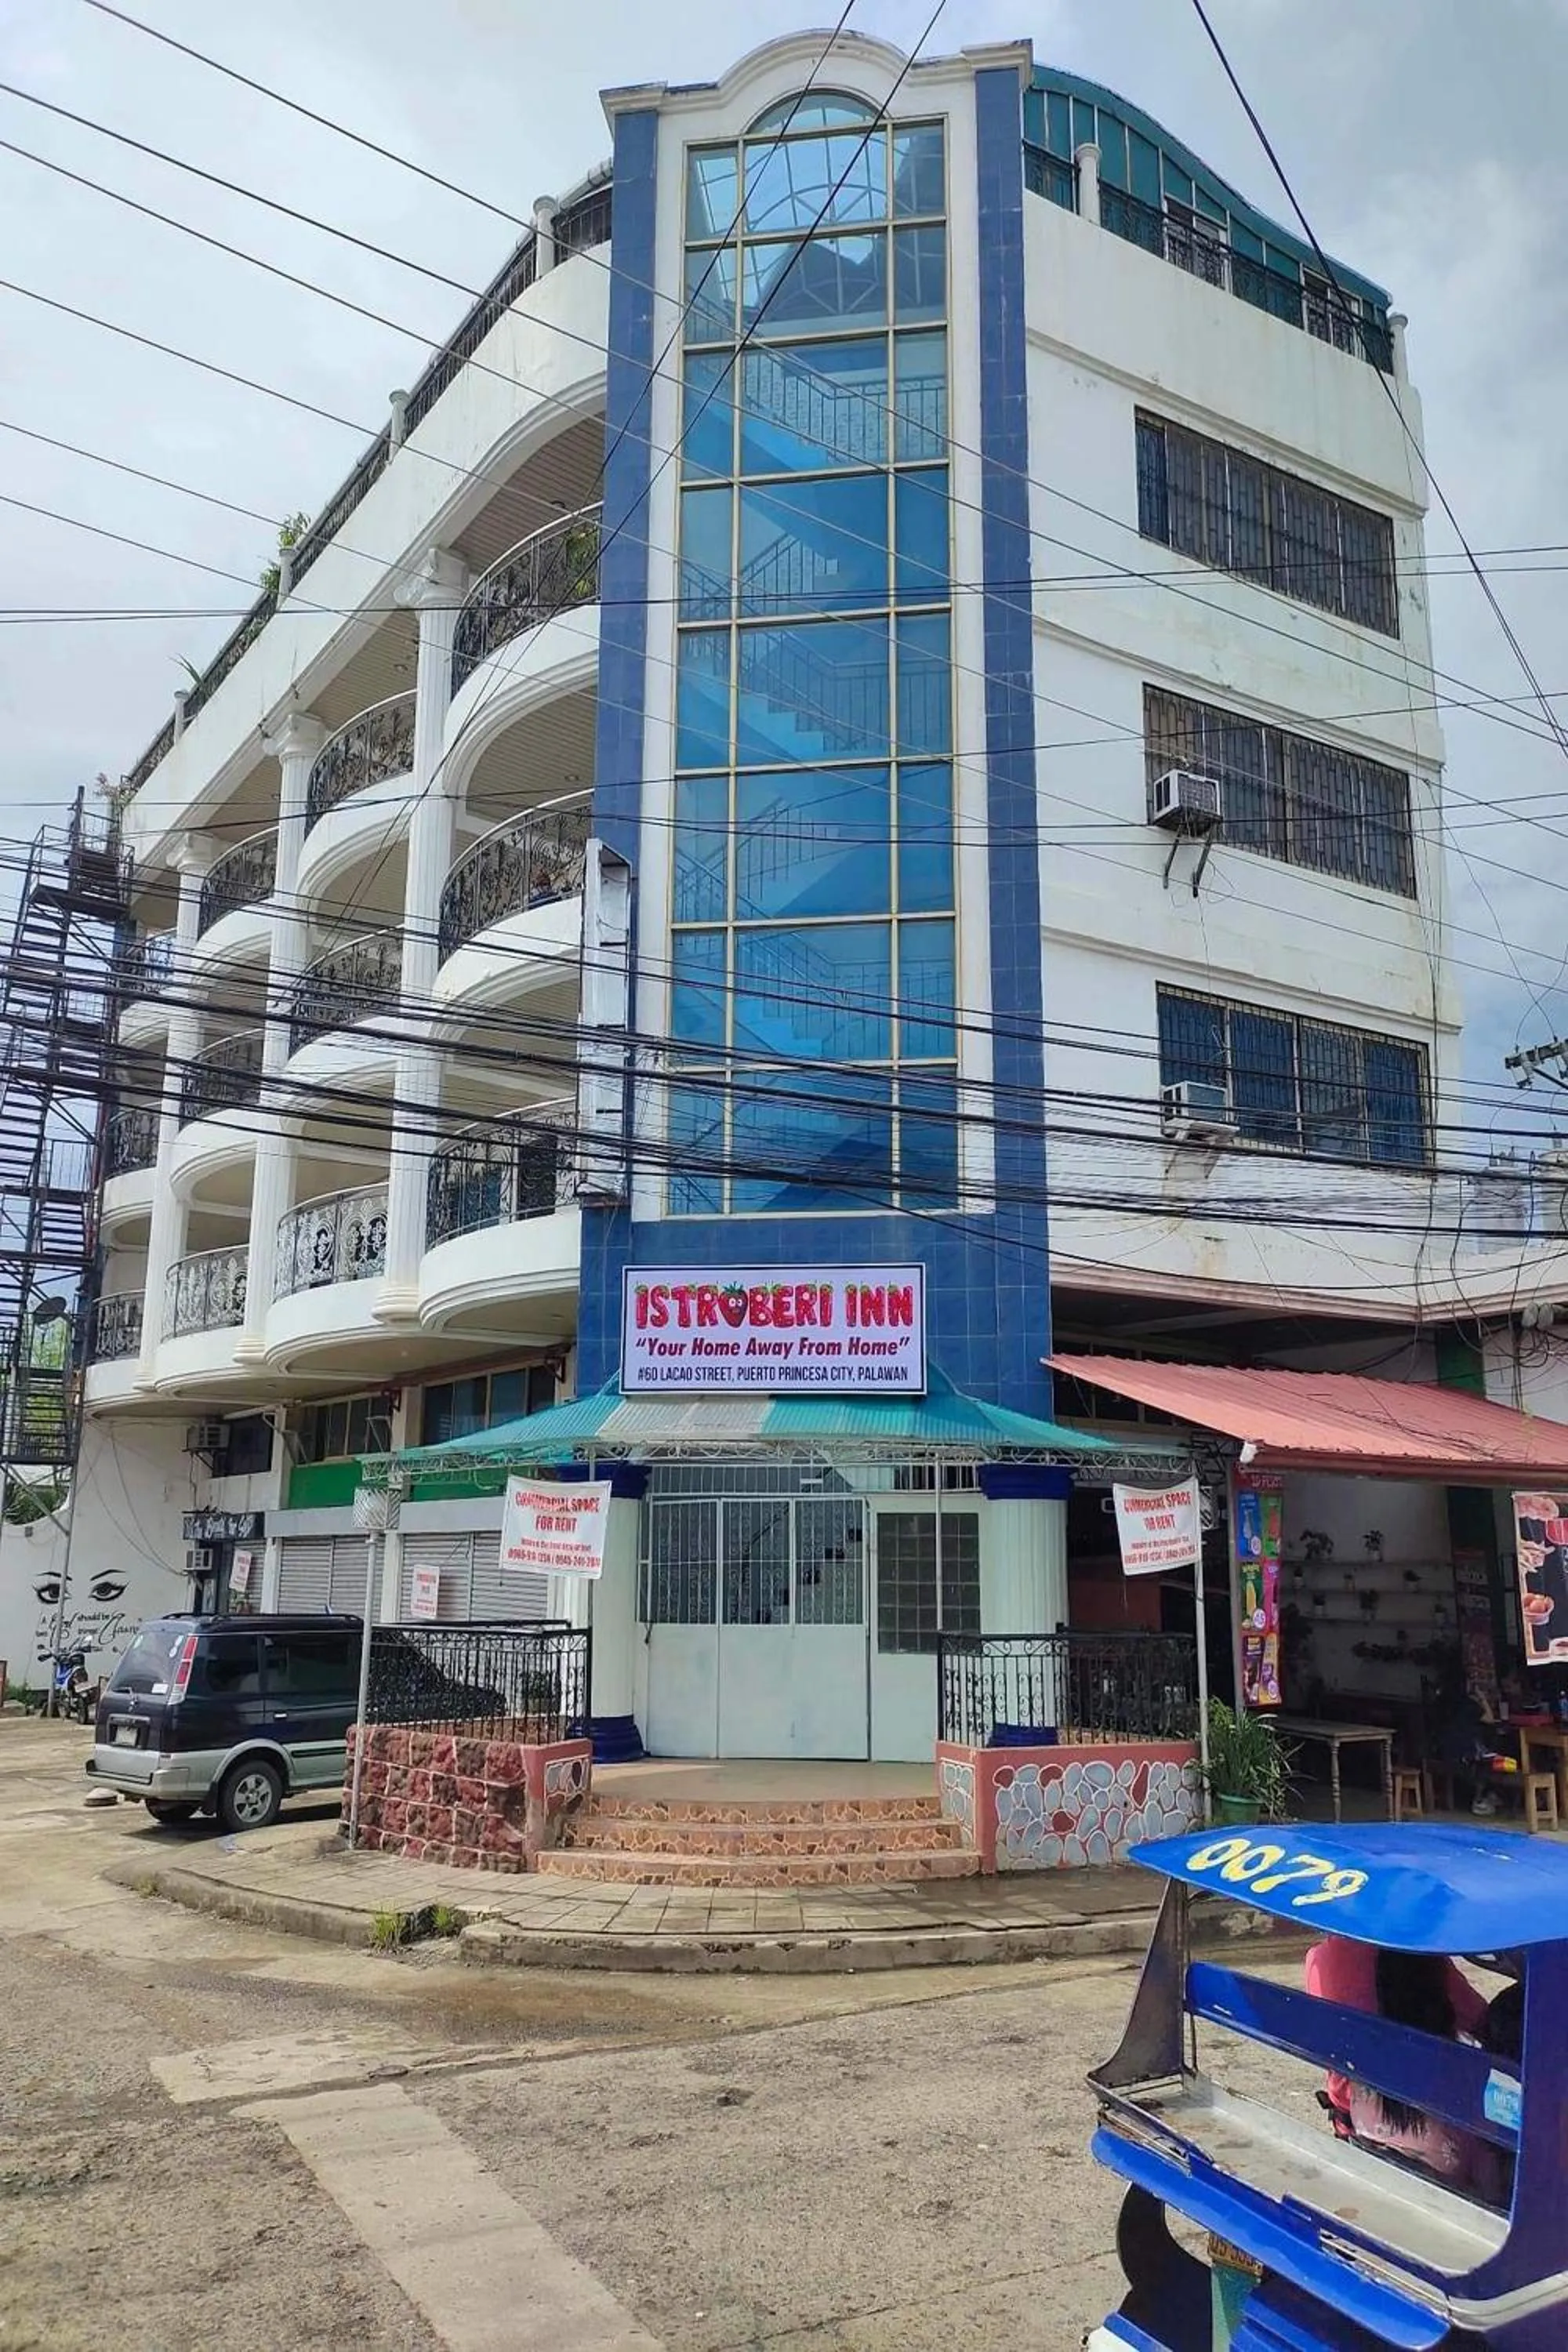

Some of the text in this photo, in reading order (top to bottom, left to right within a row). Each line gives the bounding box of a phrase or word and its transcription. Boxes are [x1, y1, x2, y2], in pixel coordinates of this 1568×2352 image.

[634, 1282, 914, 1329] ISTROBERI INN
[691, 1338, 740, 1356] Home
[745, 1338, 793, 1359] Away
[798, 1337, 841, 1356] From
[637, 1367, 908, 1382] #60 LACAO STREET, PUERTO PRINCESA CITY, PALAWAN
[572, 1497, 601, 1512] SPACE
[1166, 1492, 1191, 1507] SPACE
[536, 1515, 578, 1533] FOR RENT
[1186, 1838, 1369, 1906] 0079
